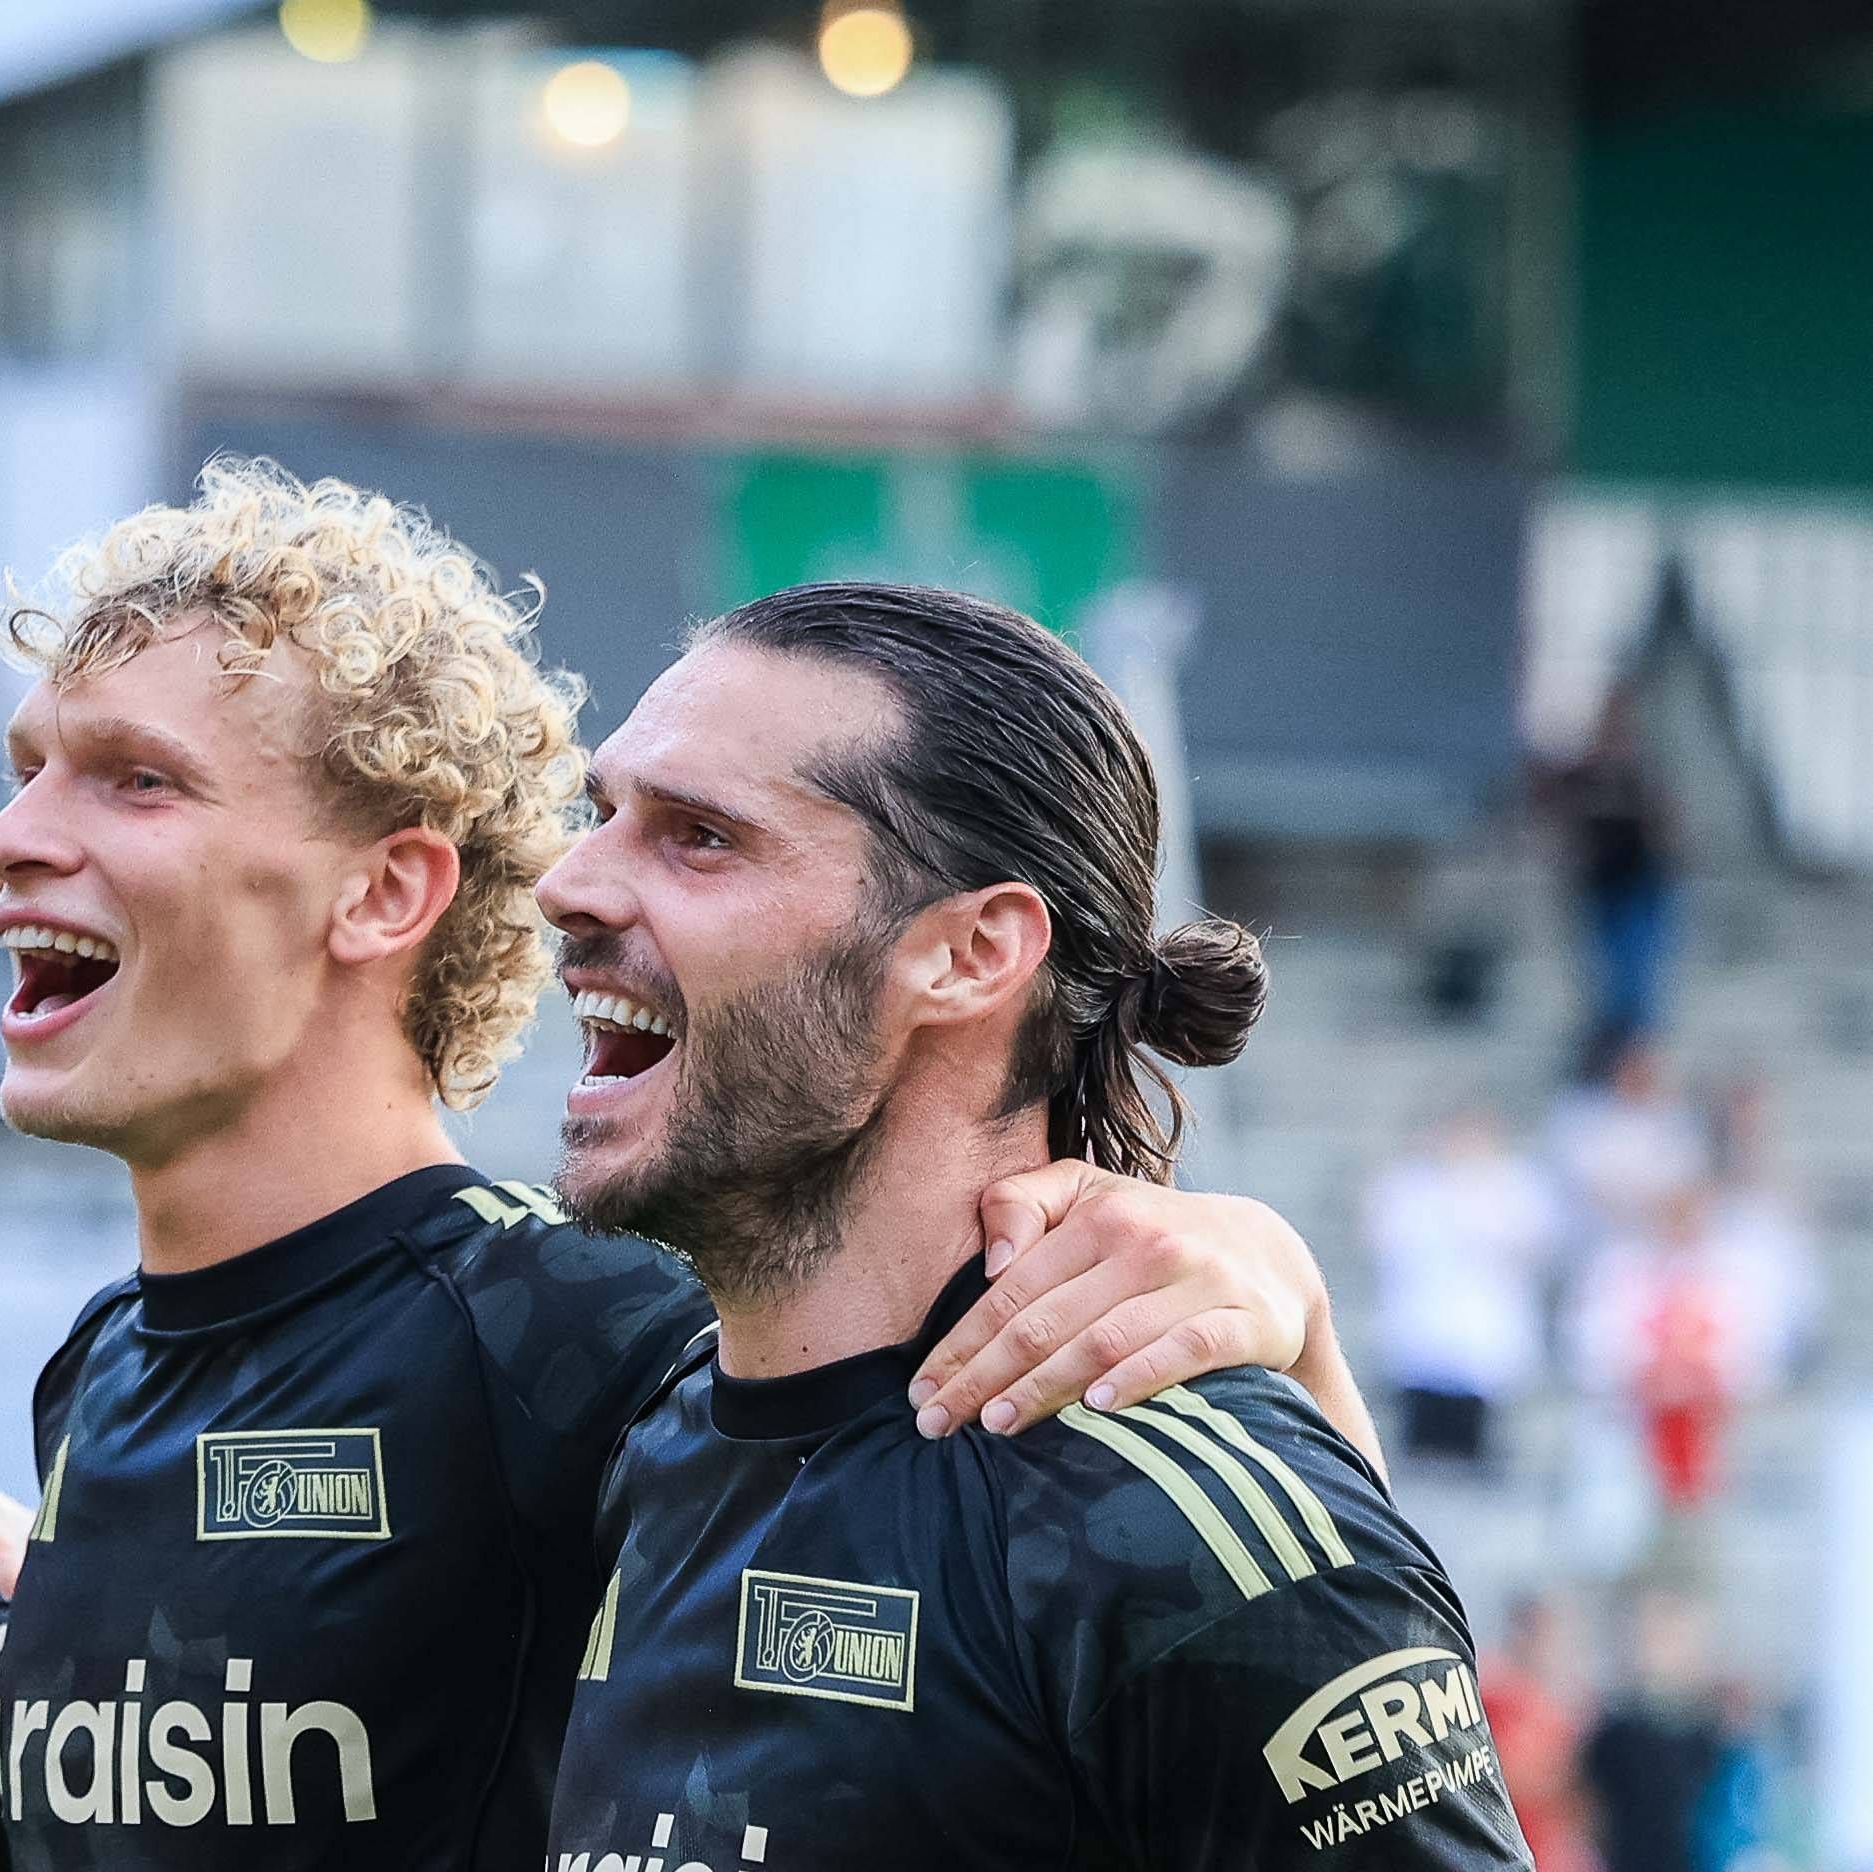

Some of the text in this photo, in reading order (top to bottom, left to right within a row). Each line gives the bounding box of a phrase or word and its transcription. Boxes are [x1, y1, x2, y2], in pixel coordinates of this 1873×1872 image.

[297, 1473, 369, 1514] UNION
[834, 1630, 902, 1681] UNION
[9, 1658, 375, 1827] raisin
[1262, 1647, 1481, 1804] KERMI
